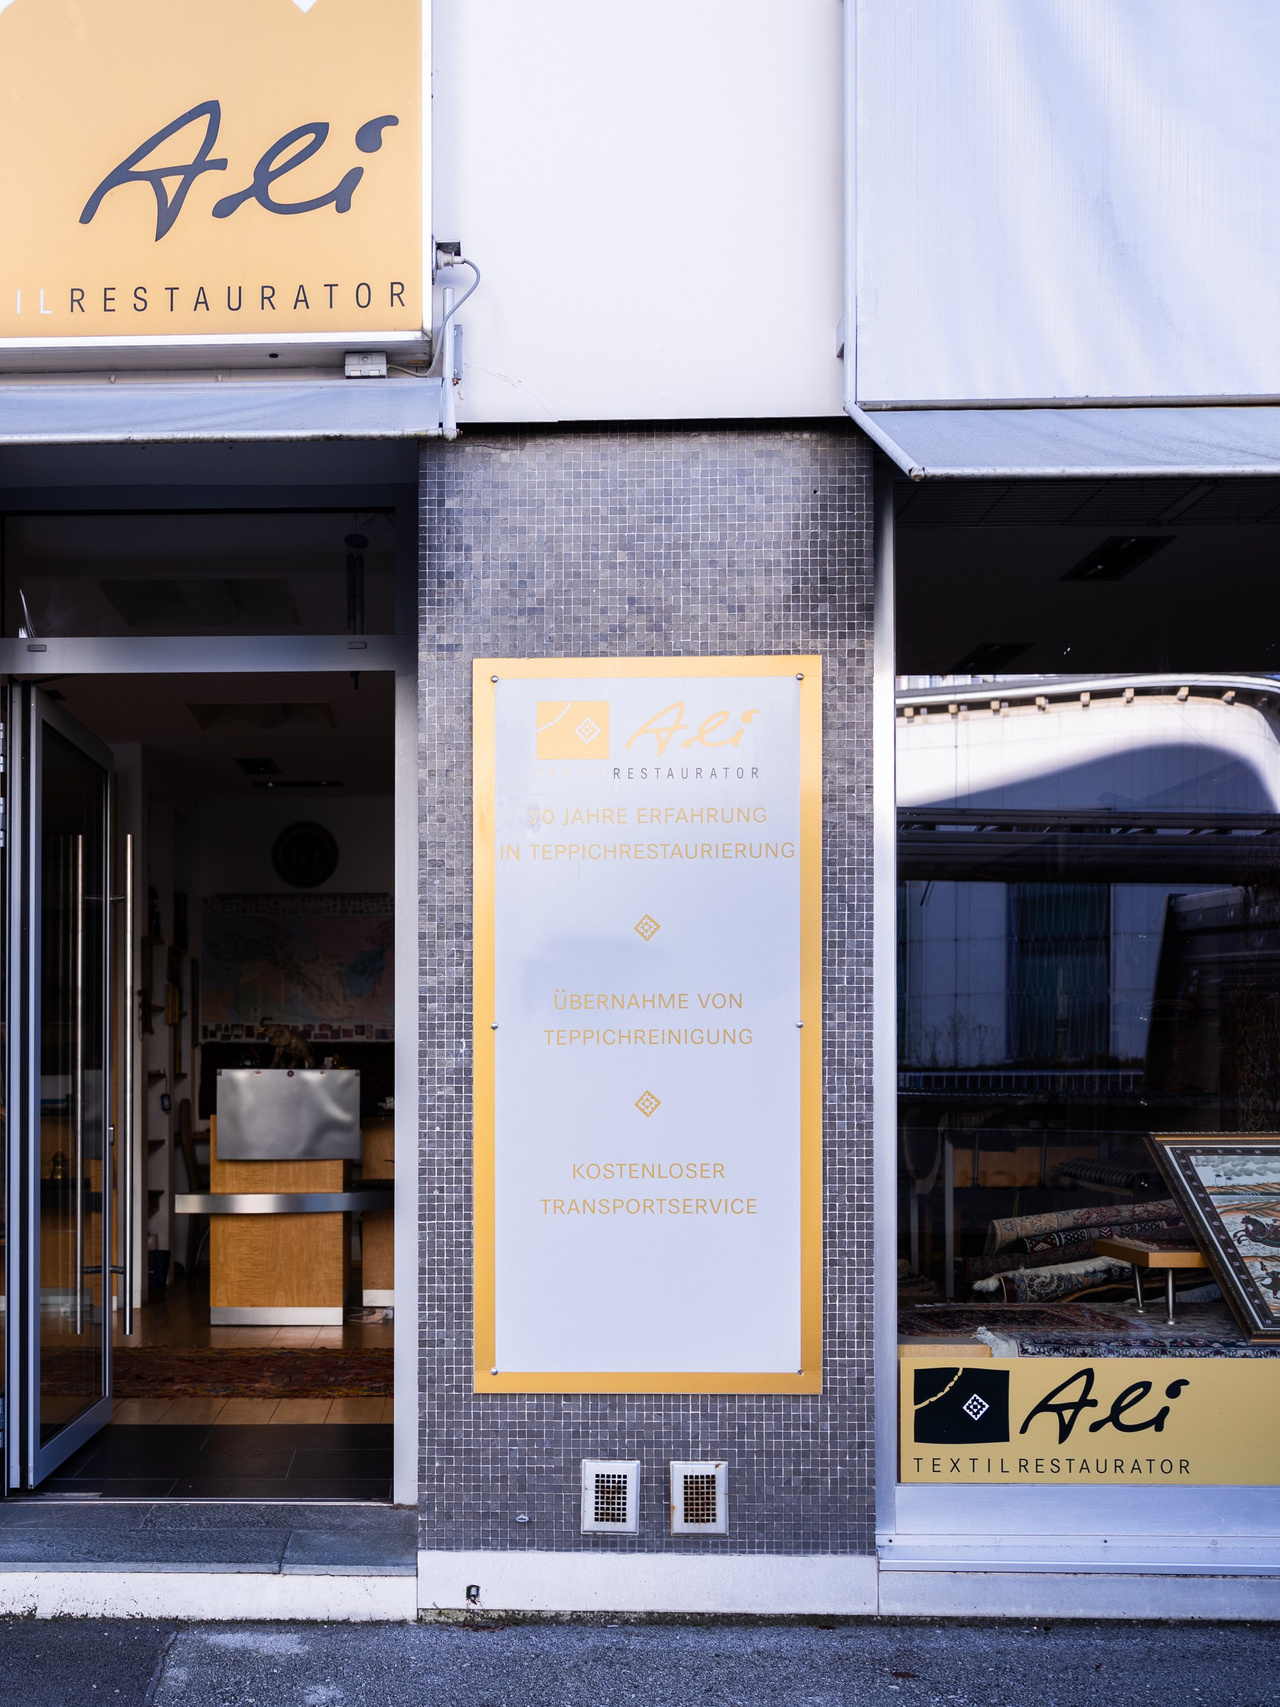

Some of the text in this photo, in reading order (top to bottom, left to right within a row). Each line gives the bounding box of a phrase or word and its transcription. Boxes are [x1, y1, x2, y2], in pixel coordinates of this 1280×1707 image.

[78, 99, 400, 243] Ali
[624, 701, 760, 757] Ali
[563, 807, 628, 826] JAHRE
[637, 807, 767, 825] ERFAHRUNG
[500, 841, 796, 861] IN TEPPICHRESTAURIERUNG
[553, 988, 743, 1011] ÜBERNAHME VON
[543, 1028, 753, 1046] TEPPICHREINIGUNG
[572, 1162, 725, 1180] KOSTENLOSER
[539, 1199, 756, 1215] TRANSPORTSERVICE
[1019, 1367, 1191, 1445] Ali
